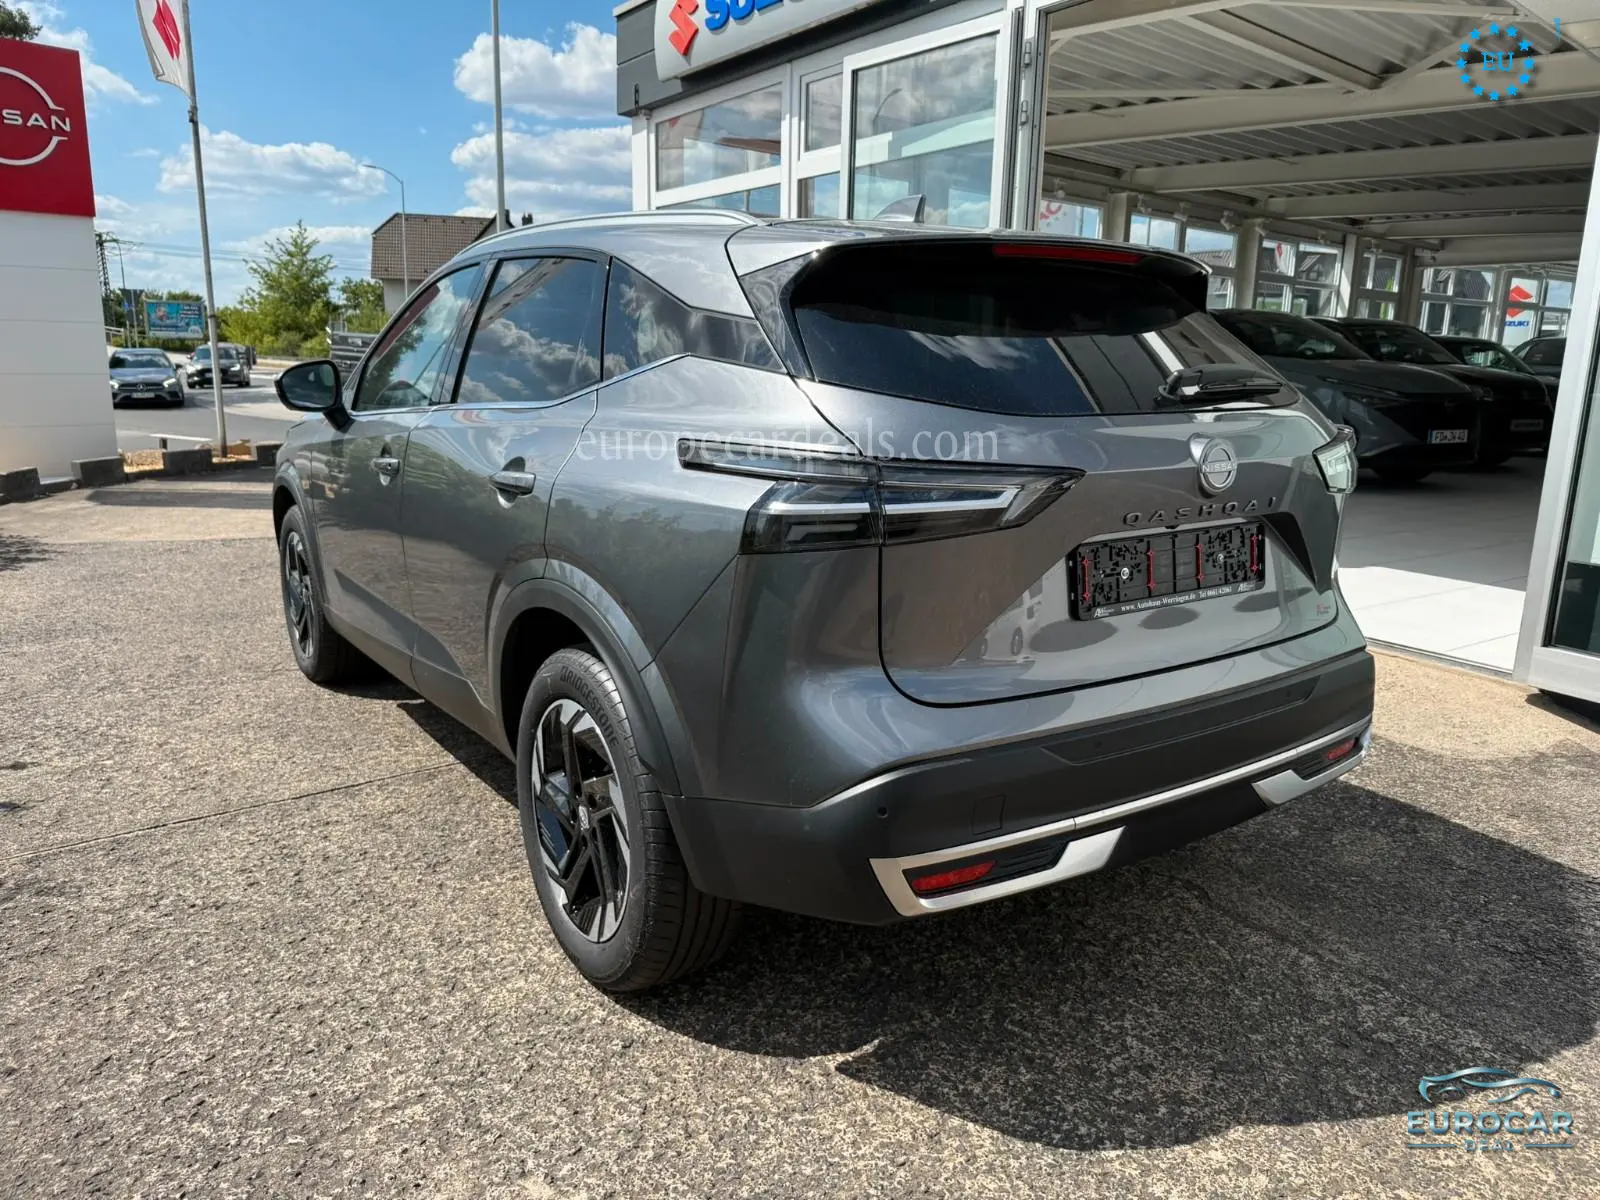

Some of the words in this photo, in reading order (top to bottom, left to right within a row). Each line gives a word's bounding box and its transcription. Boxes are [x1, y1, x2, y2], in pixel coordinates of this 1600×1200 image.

[705, 0, 784, 32] SU
[1123, 496, 1276, 527] QASHQAI
[560, 665, 619, 747] BRIDGESTONE
